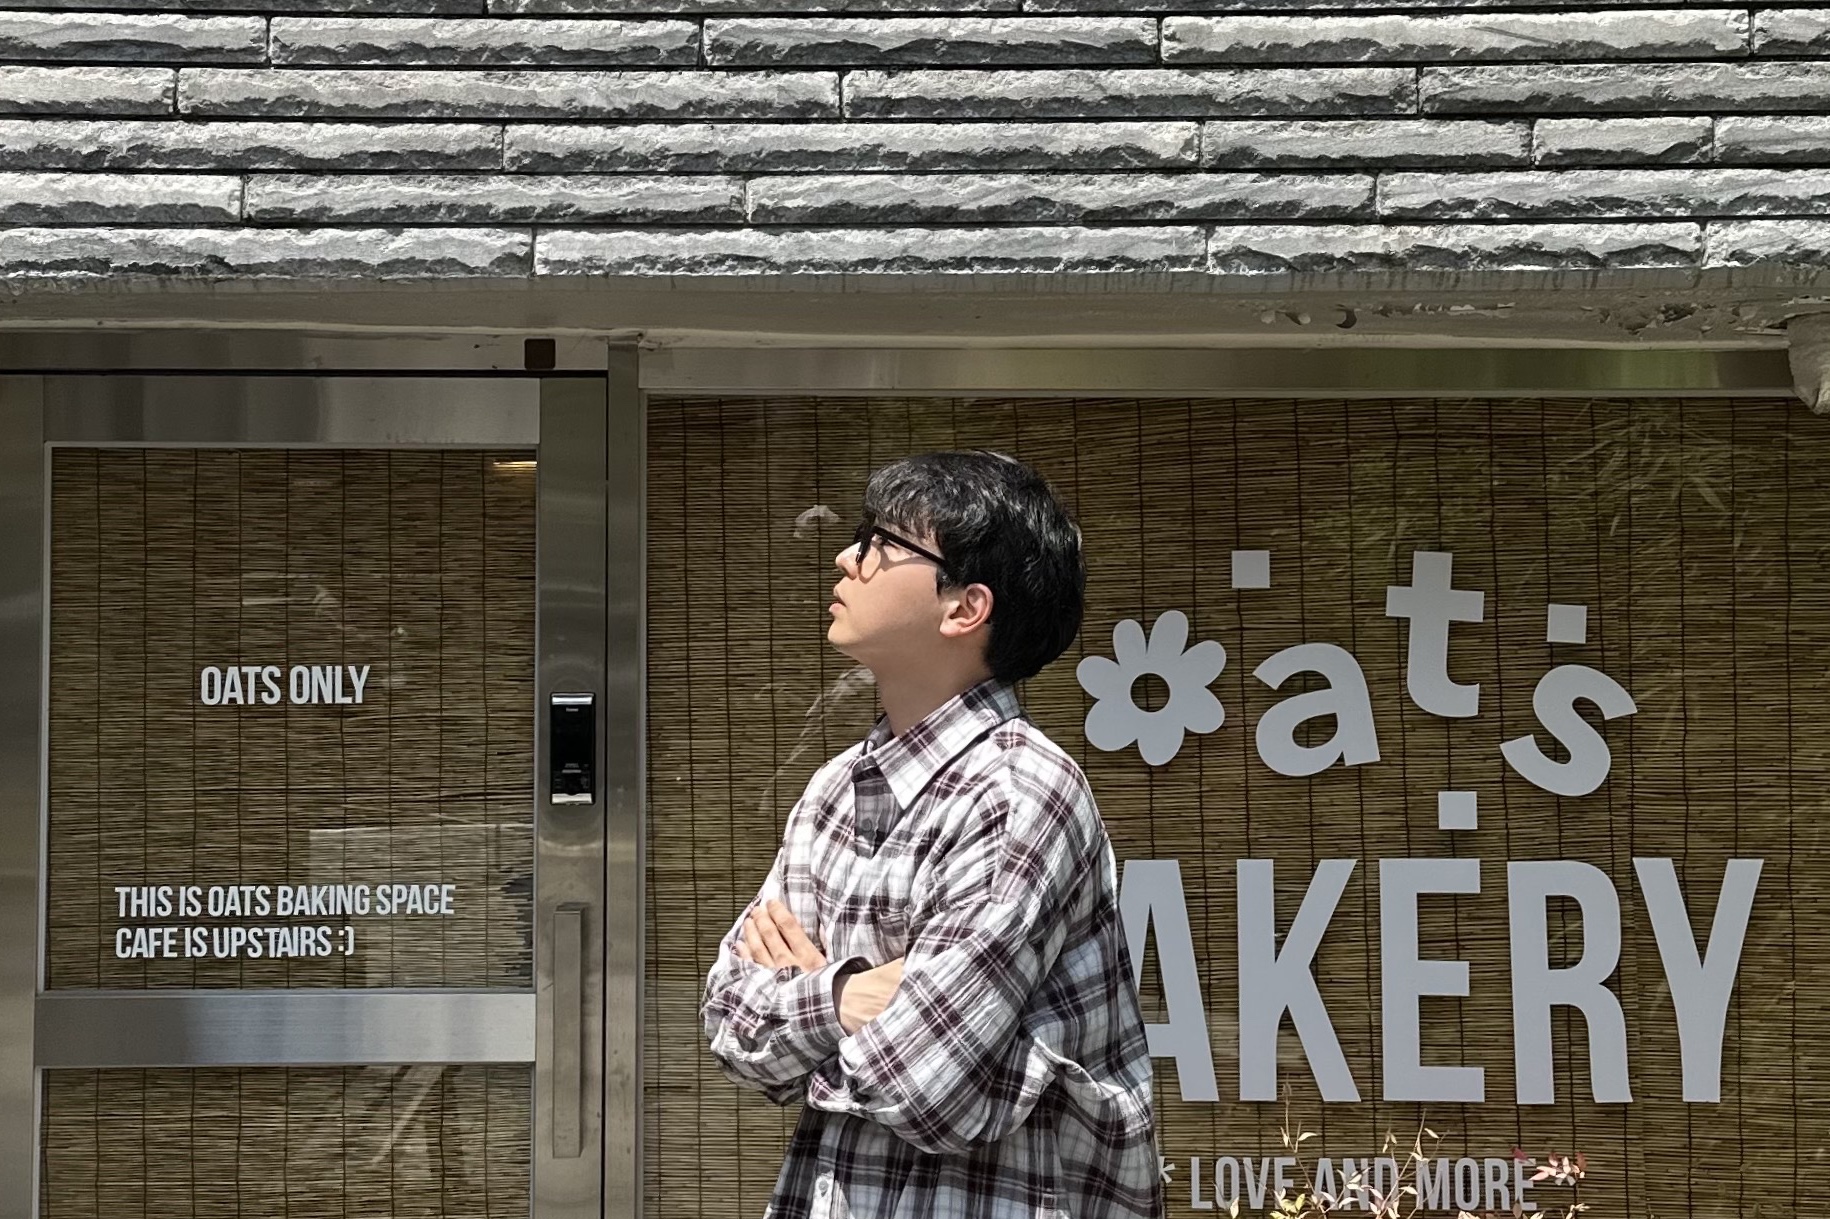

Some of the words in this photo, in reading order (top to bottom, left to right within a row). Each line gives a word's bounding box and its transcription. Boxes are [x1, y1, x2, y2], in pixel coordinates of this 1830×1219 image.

[201, 665, 282, 705] OATS
[289, 665, 371, 704] ONLY
[115, 886, 172, 917] THIS
[179, 886, 202, 917] IS
[207, 885, 271, 916] OATS
[276, 885, 371, 916] BAKING
[375, 884, 456, 915] SPACE
[115, 927, 178, 958] CAFE
[185, 927, 208, 957] IS
[213, 926, 332, 958] UPSTAIRS
[1118, 858, 1764, 1104] AKERY
[1190, 1156, 1296, 1210] LOVE
[1314, 1157, 1399, 1211] AND
[1417, 1157, 1537, 1211] MORE
